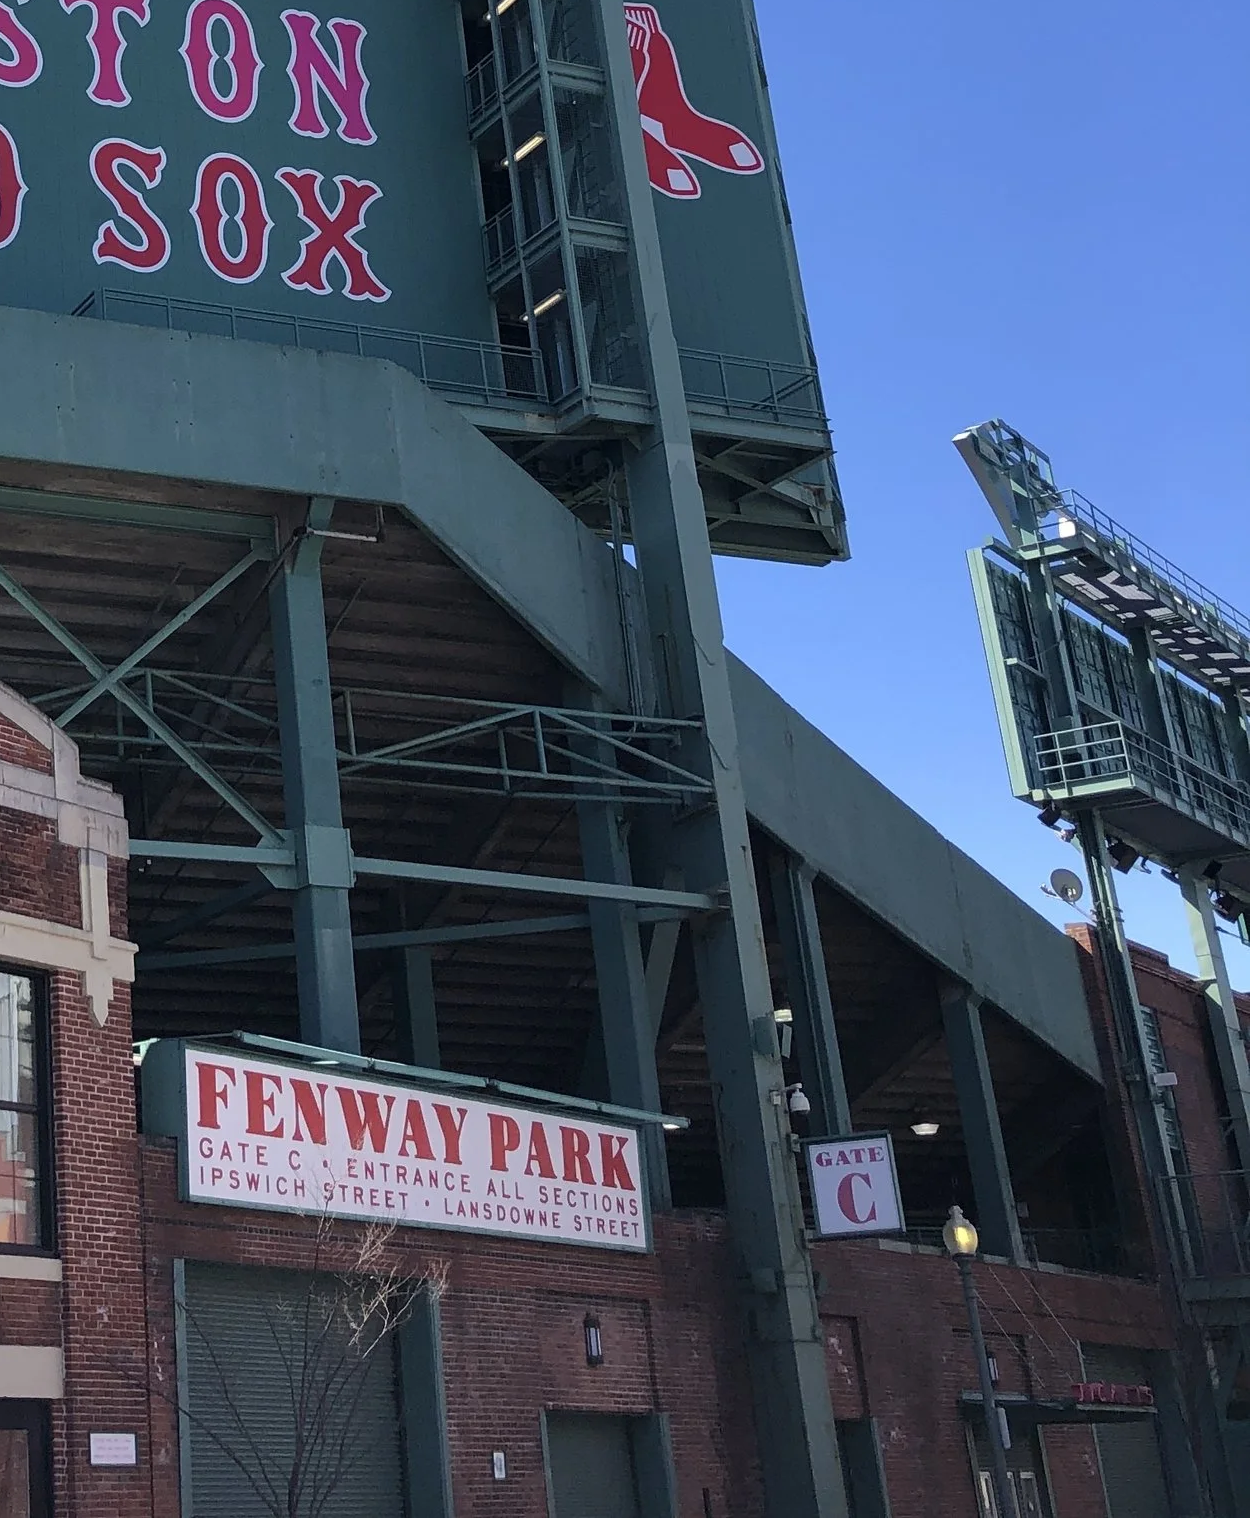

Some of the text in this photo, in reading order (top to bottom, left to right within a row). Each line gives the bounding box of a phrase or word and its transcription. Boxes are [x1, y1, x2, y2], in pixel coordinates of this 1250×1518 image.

[89, 137, 393, 304] SOX
[195, 1061, 637, 1191] FENWAY PARK
[815, 1146, 885, 1167] GATE
[199, 1137, 639, 1217] GATE C ENTRANCE ALL SECTIONS
[200, 1166, 639, 1238] IPSWICH STREET LANSDOWNE STREET
[837, 1172, 877, 1224] C
